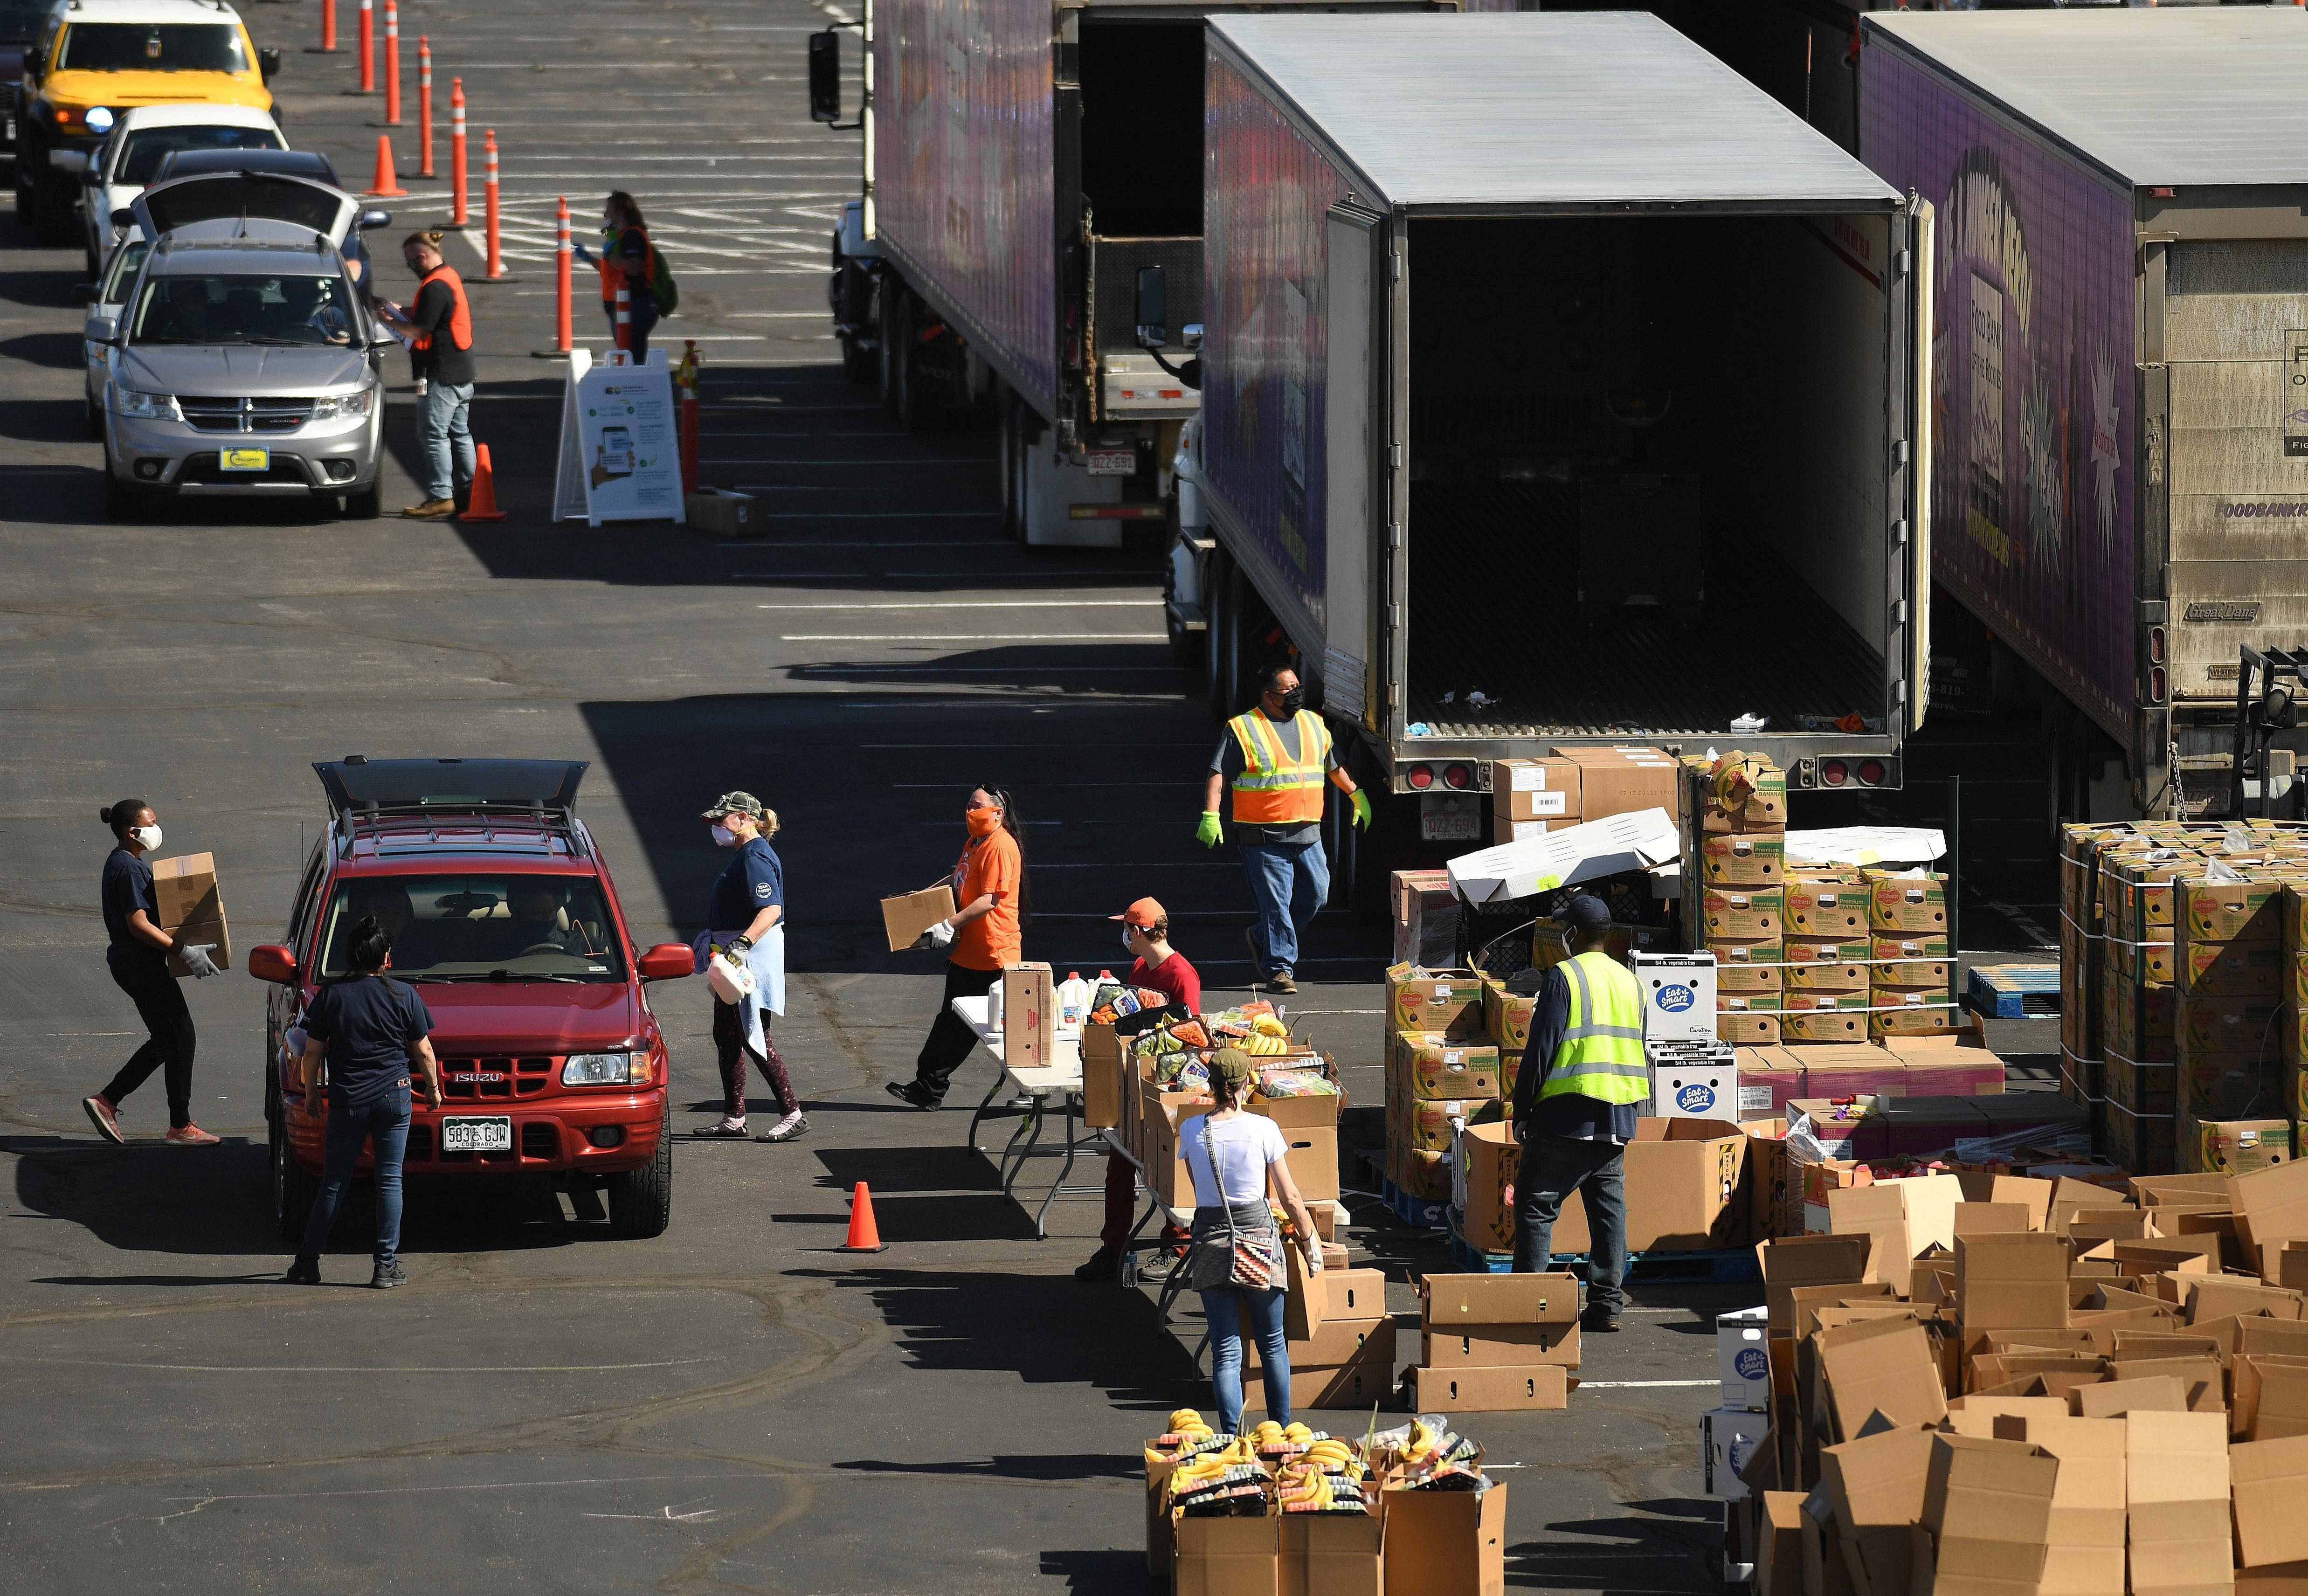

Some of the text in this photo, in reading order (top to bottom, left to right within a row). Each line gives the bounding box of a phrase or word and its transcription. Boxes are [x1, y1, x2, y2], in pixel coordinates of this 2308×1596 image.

[1942, 187, 1954, 293] BE
[1957, 176, 1963, 262] A
[1972, 299, 2001, 352] FOOD BANK
[2188, 603, 2256, 619] Great Dane
[1665, 987, 1681, 998] Eat
[1661, 994, 1688, 1007] Smart
[455, 1073, 500, 1082] ISUZU
[1686, 1087, 1702, 1098] Eat
[1682, 1094, 1708, 1107] Smart
[449, 1127, 506, 1142] 583 GJW
[1743, 1352, 1756, 1363] Eat
[1740, 1361, 1764, 1373] Smart
